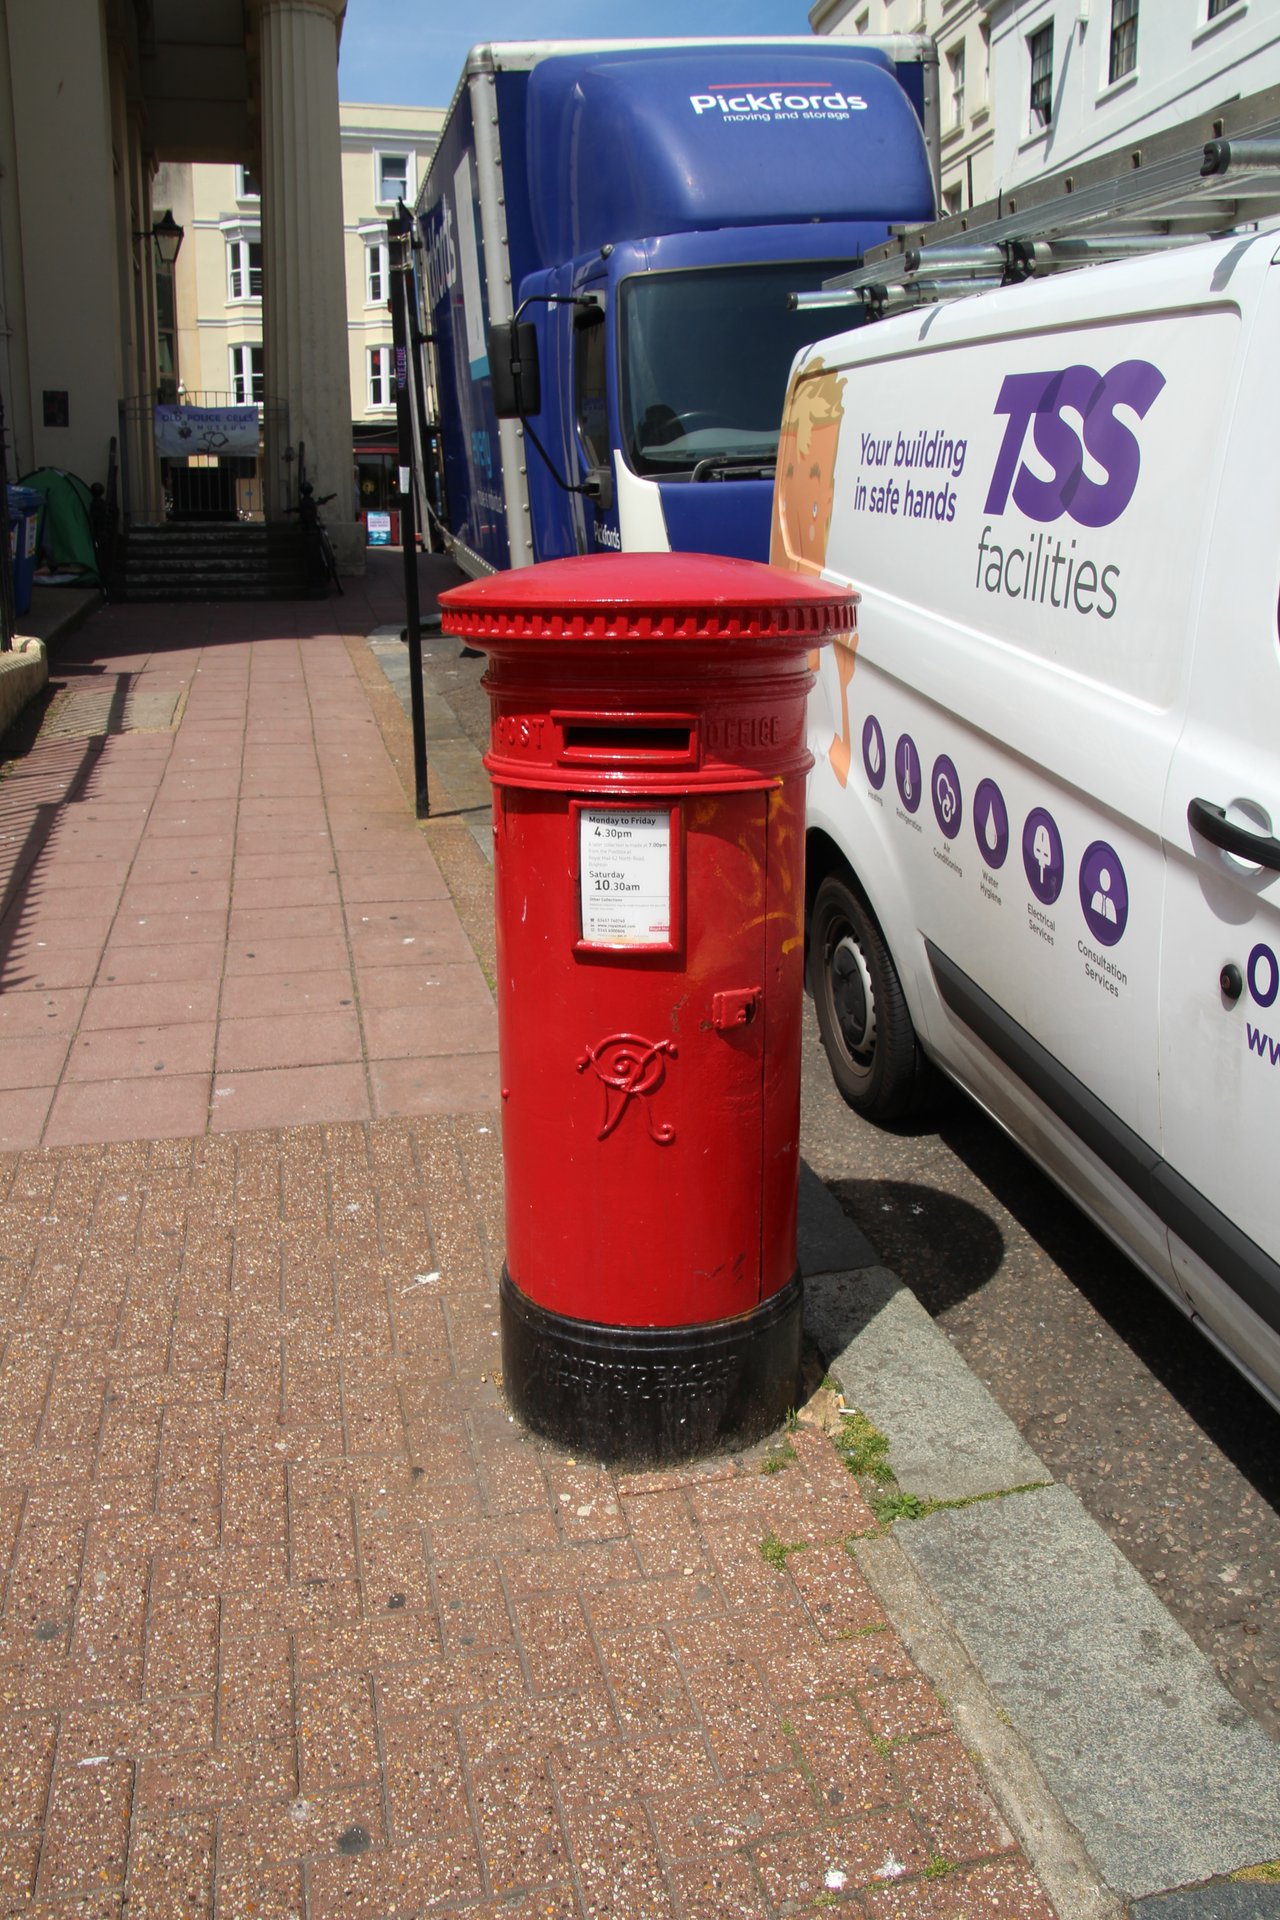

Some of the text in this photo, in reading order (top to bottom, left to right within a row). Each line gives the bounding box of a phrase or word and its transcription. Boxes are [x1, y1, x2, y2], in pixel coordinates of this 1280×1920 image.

[689, 92, 868, 114] Pickfords
[723, 110, 850, 122] moving and storage
[161, 412, 254, 422] OLD POLICE CELLS
[860, 430, 968, 478] Your building
[983, 359, 1167, 528] TSS
[854, 476, 957, 522] in safe hands
[975, 525, 1121, 620] facilities
[497, 715, 781, 750] POST OFFICE
[588, 816, 657, 827] Monday to Friday
[594, 826, 632, 839] 4.30pm
[589, 870, 625, 879] Saturday
[933, 847, 963, 878] Conditioning
[594, 879, 641, 891] 10.30am
[981, 869, 999, 889] Water
[979, 882, 1002, 906] Hygiene
[1027, 903, 1056, 932] Electrical
[1028, 919, 1055, 946] Services
[1077, 940, 1128, 985] Consultation
[1084, 962, 1119, 998] Services
